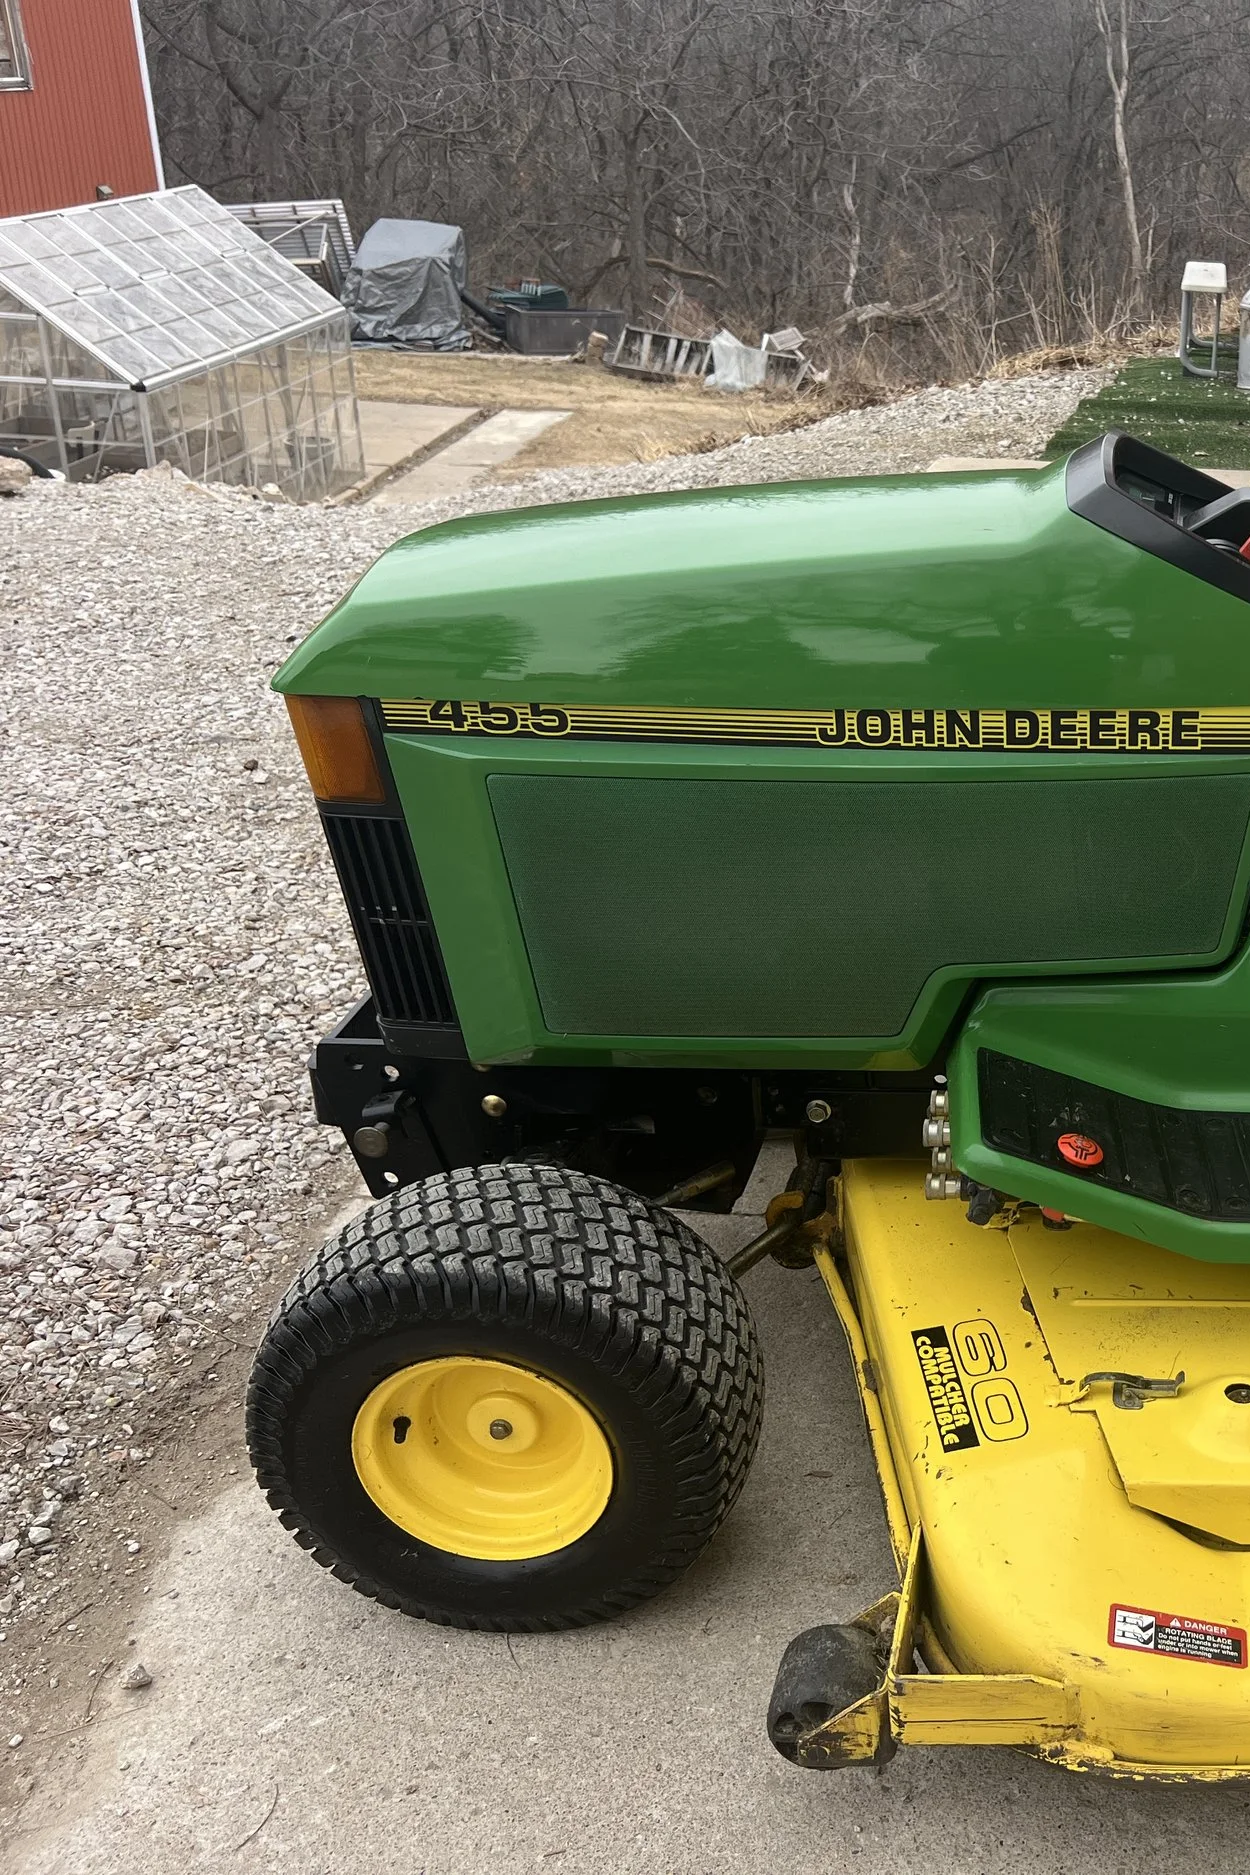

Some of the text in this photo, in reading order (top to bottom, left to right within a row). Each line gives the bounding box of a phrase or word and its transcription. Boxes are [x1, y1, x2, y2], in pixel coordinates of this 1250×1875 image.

[426, 700, 572, 736] 455
[816, 708, 1201, 750] JOHN DEERE
[916, 1336, 960, 1446] COMPATIBLE
[934, 1346, 970, 1427] MULCHER
[952, 1318, 1028, 1442] 60
[1165, 1628, 1232, 1646] ROTATING BLADE
[1184, 1620, 1227, 1636] DANGER
[1158, 1638, 1177, 1647] under
[1158, 1644, 1179, 1653] engine
[1188, 1650, 1212, 1659] running
[1192, 1638, 1211, 1647] hands
